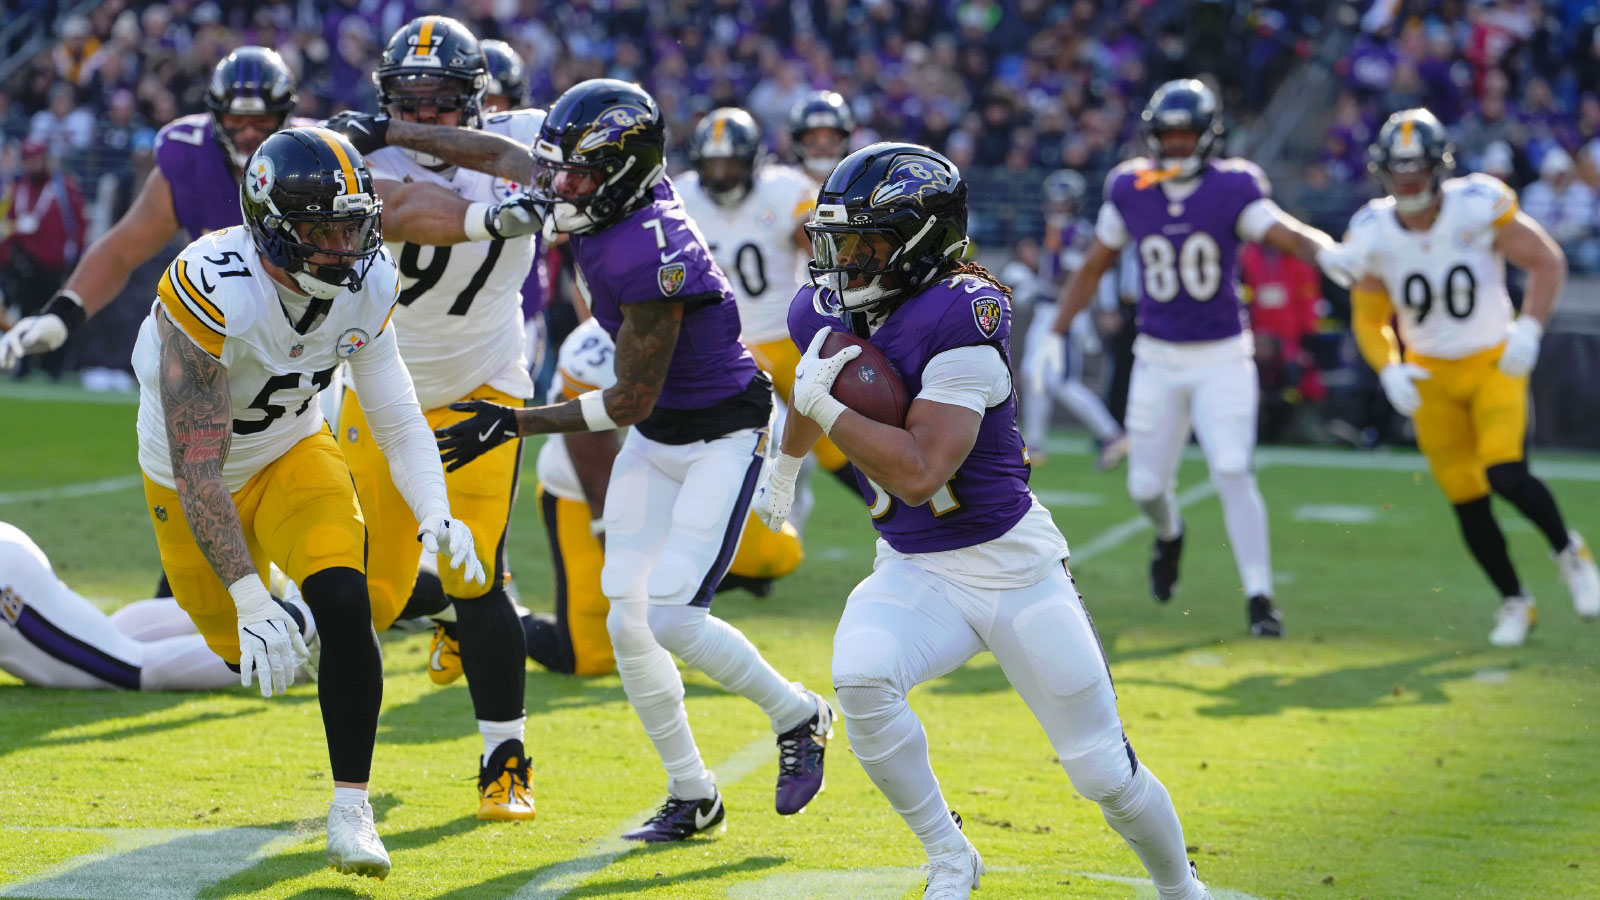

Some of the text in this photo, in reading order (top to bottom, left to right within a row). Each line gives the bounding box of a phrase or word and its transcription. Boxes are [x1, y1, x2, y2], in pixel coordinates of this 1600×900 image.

[333, 167, 364, 196] 51
[202, 251, 253, 278] 51
[641, 218, 668, 250] 7
[399, 239, 506, 316] 97
[1140, 232, 1221, 302] 80
[1404, 264, 1476, 325] 90
[232, 364, 338, 435] 51
